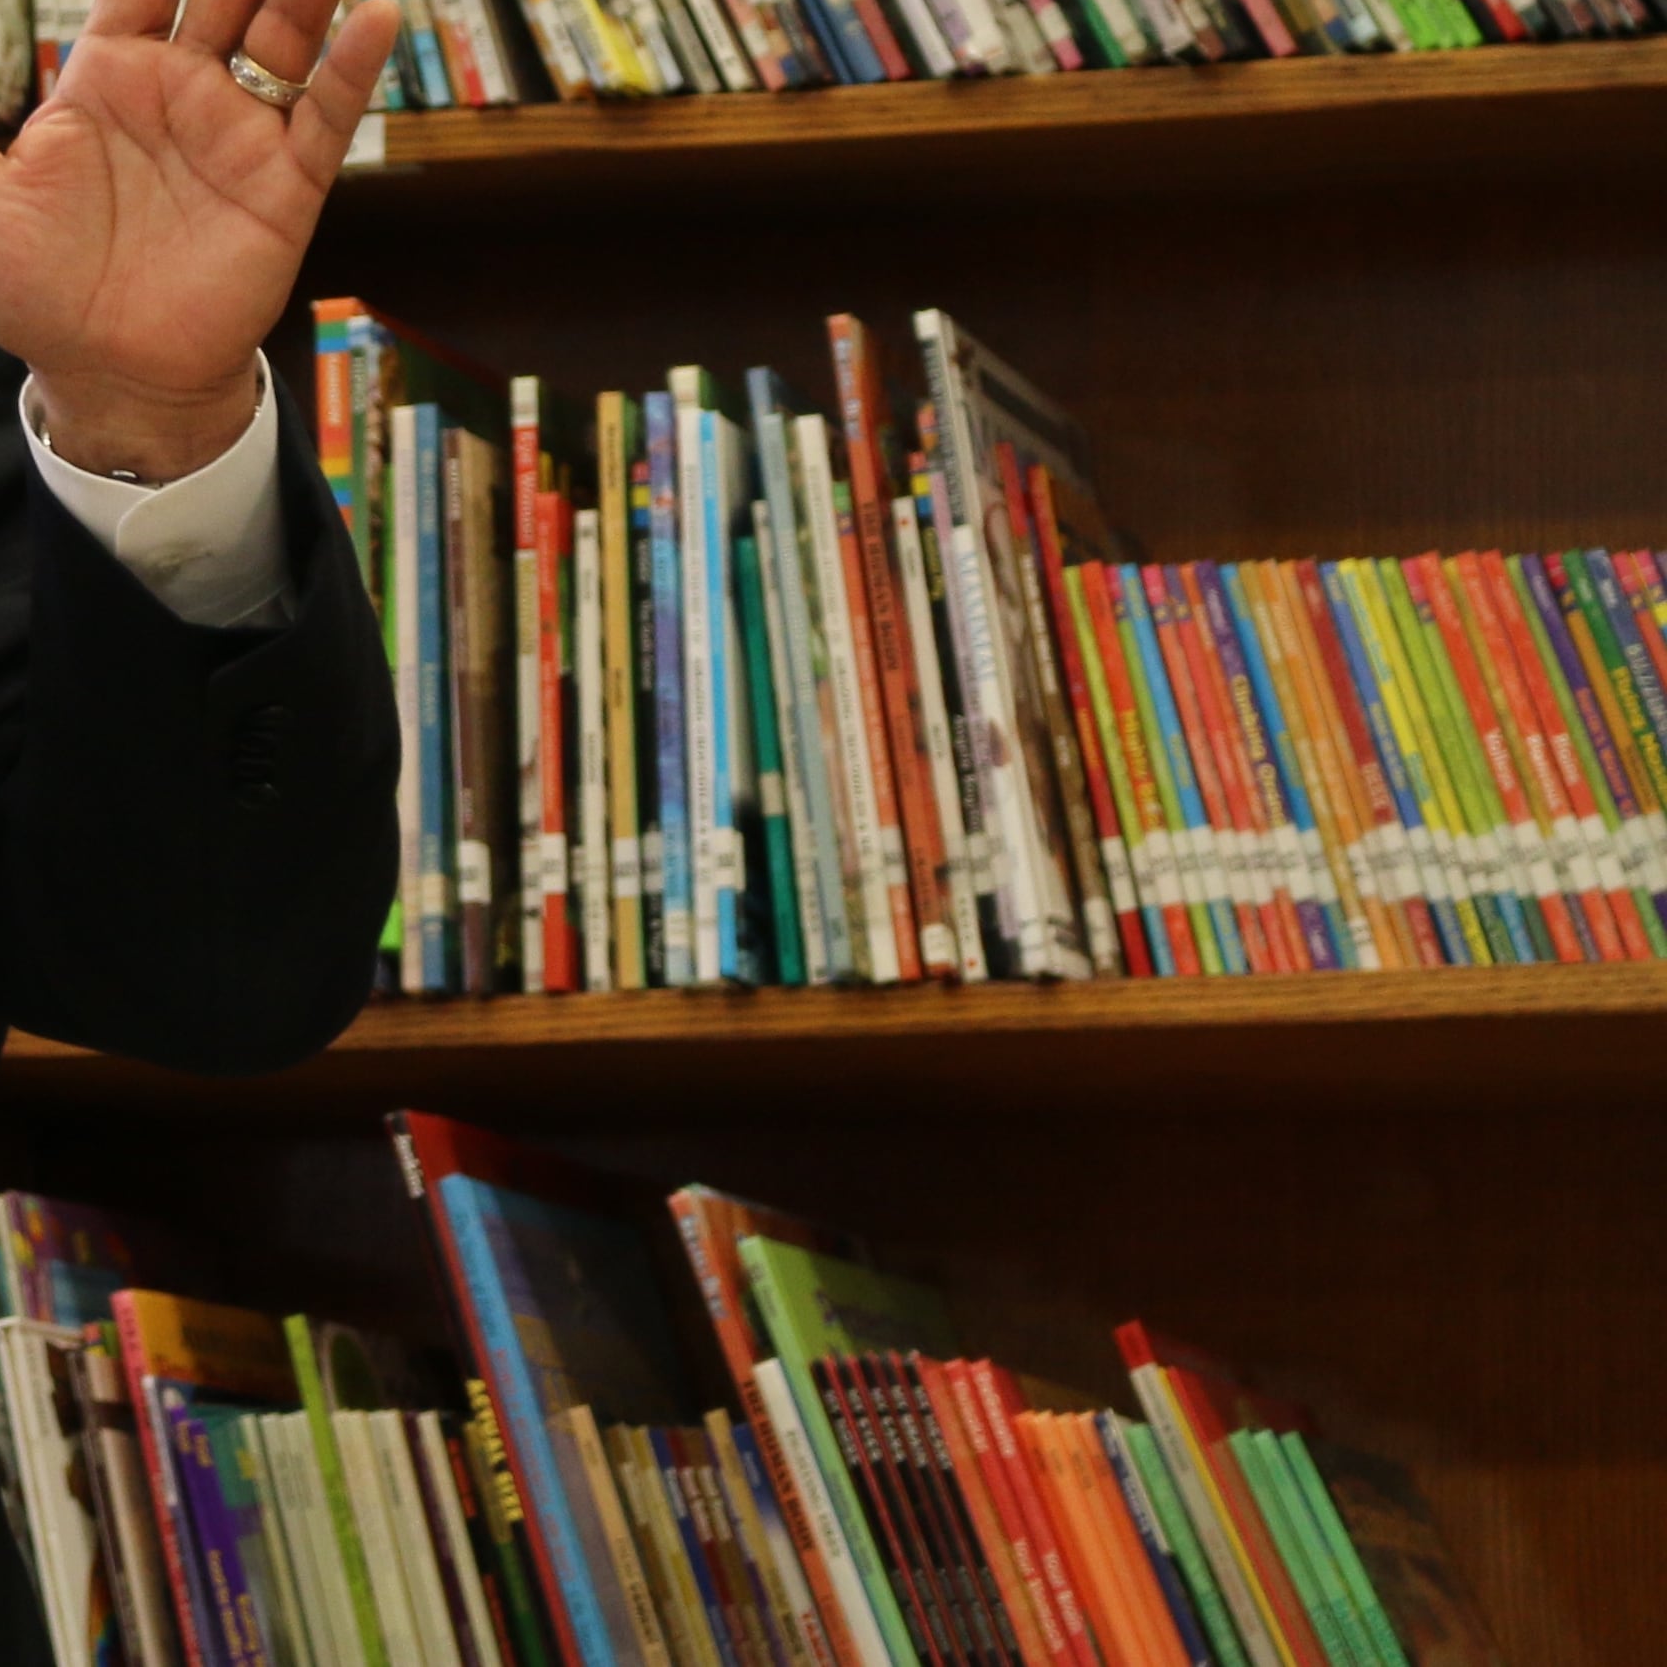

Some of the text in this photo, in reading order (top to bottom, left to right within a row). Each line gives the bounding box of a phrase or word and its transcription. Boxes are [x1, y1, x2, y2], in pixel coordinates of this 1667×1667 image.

[867, 540, 892, 615] HUMAN
[879, 619, 900, 672] BODY
[464, 1375, 525, 1524] ACTUAL SIZE
[742, 1378, 815, 1552] THE HUMAN BODY
